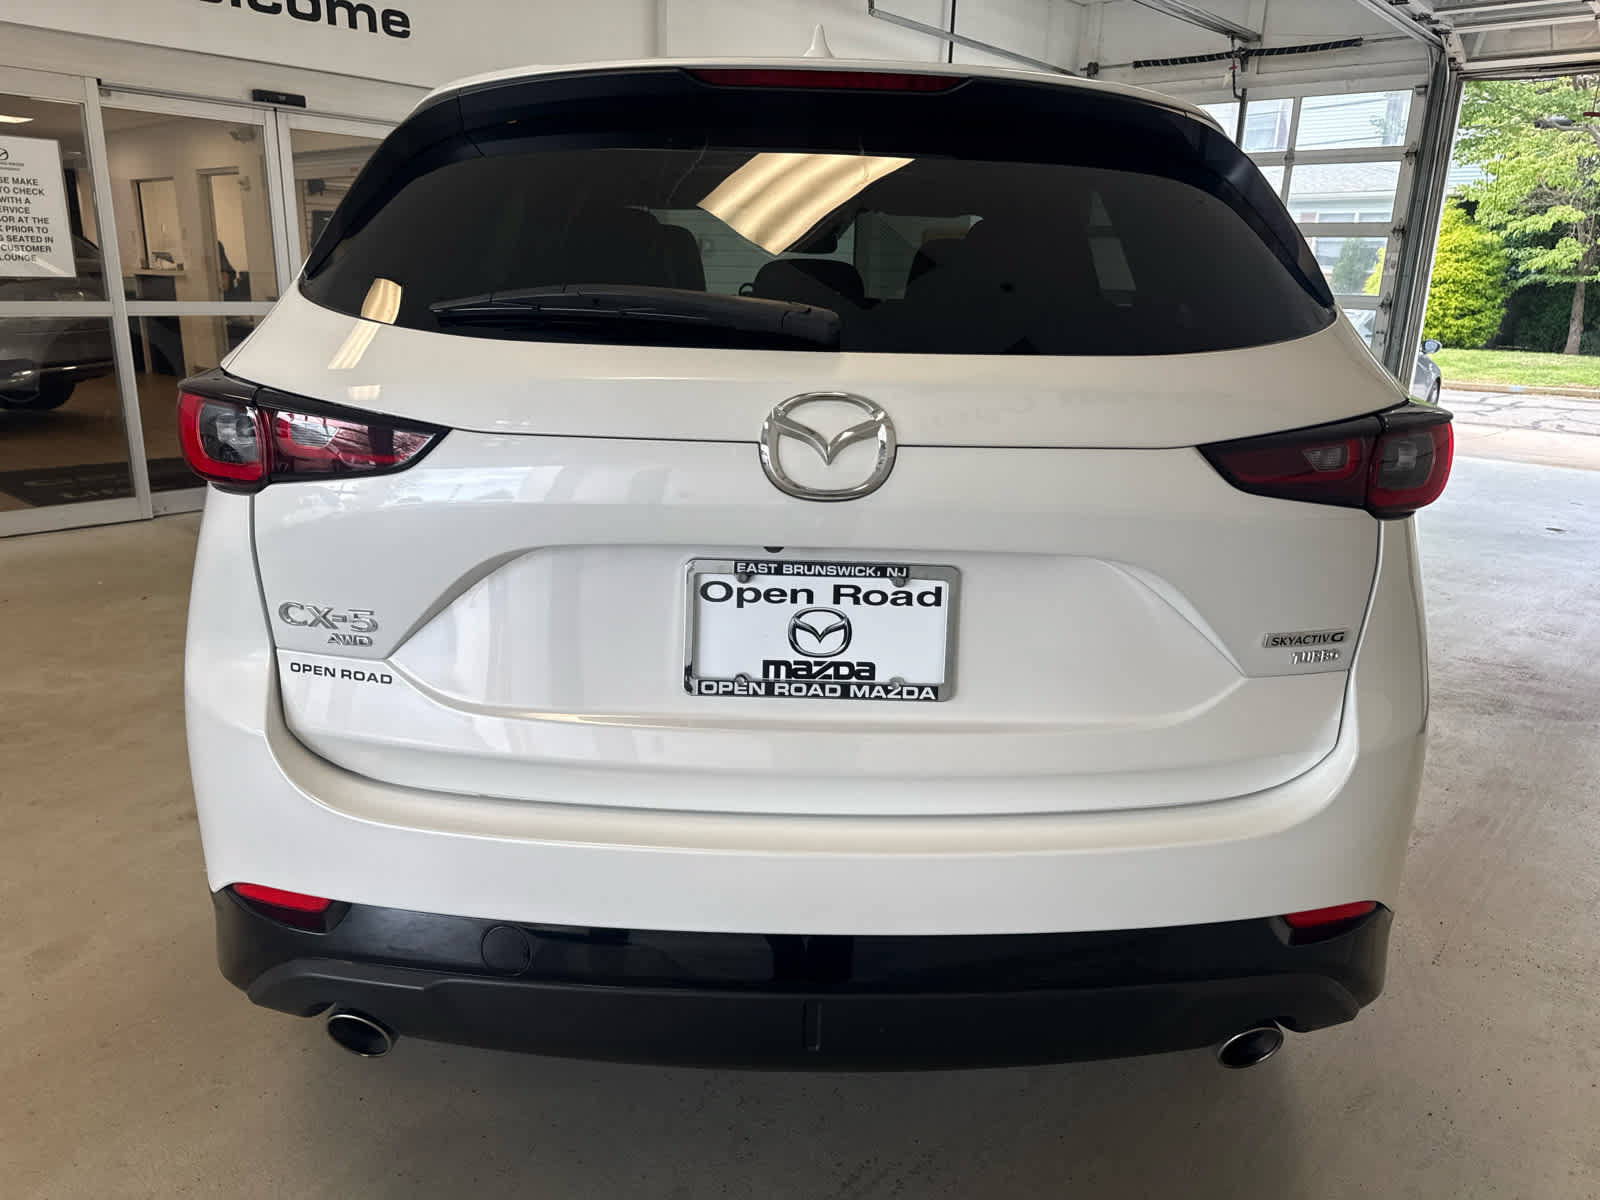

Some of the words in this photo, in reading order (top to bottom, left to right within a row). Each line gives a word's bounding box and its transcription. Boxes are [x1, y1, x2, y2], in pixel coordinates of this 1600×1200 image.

[12, 177, 39, 186] MAKE
[13, 187, 45, 196] CHECK
[6, 225, 34, 233] PRIOR
[36, 226, 48, 234] TO
[7, 235, 42, 243] SEATED
[1, 244, 52, 252] CUSTOMER
[736, 562, 778, 574] EAST
[886, 567, 907, 577] NJ
[700, 581, 814, 608] Open
[832, 584, 942, 606] Road
[278, 601, 379, 633] CX-5
[327, 632, 374, 647] AWD
[290, 662, 336, 678] OPEN
[340, 669, 393, 685] ROAD
[701, 681, 765, 696] OPEN
[774, 683, 841, 697] ROAD
[850, 686, 936, 700] MAZDA
